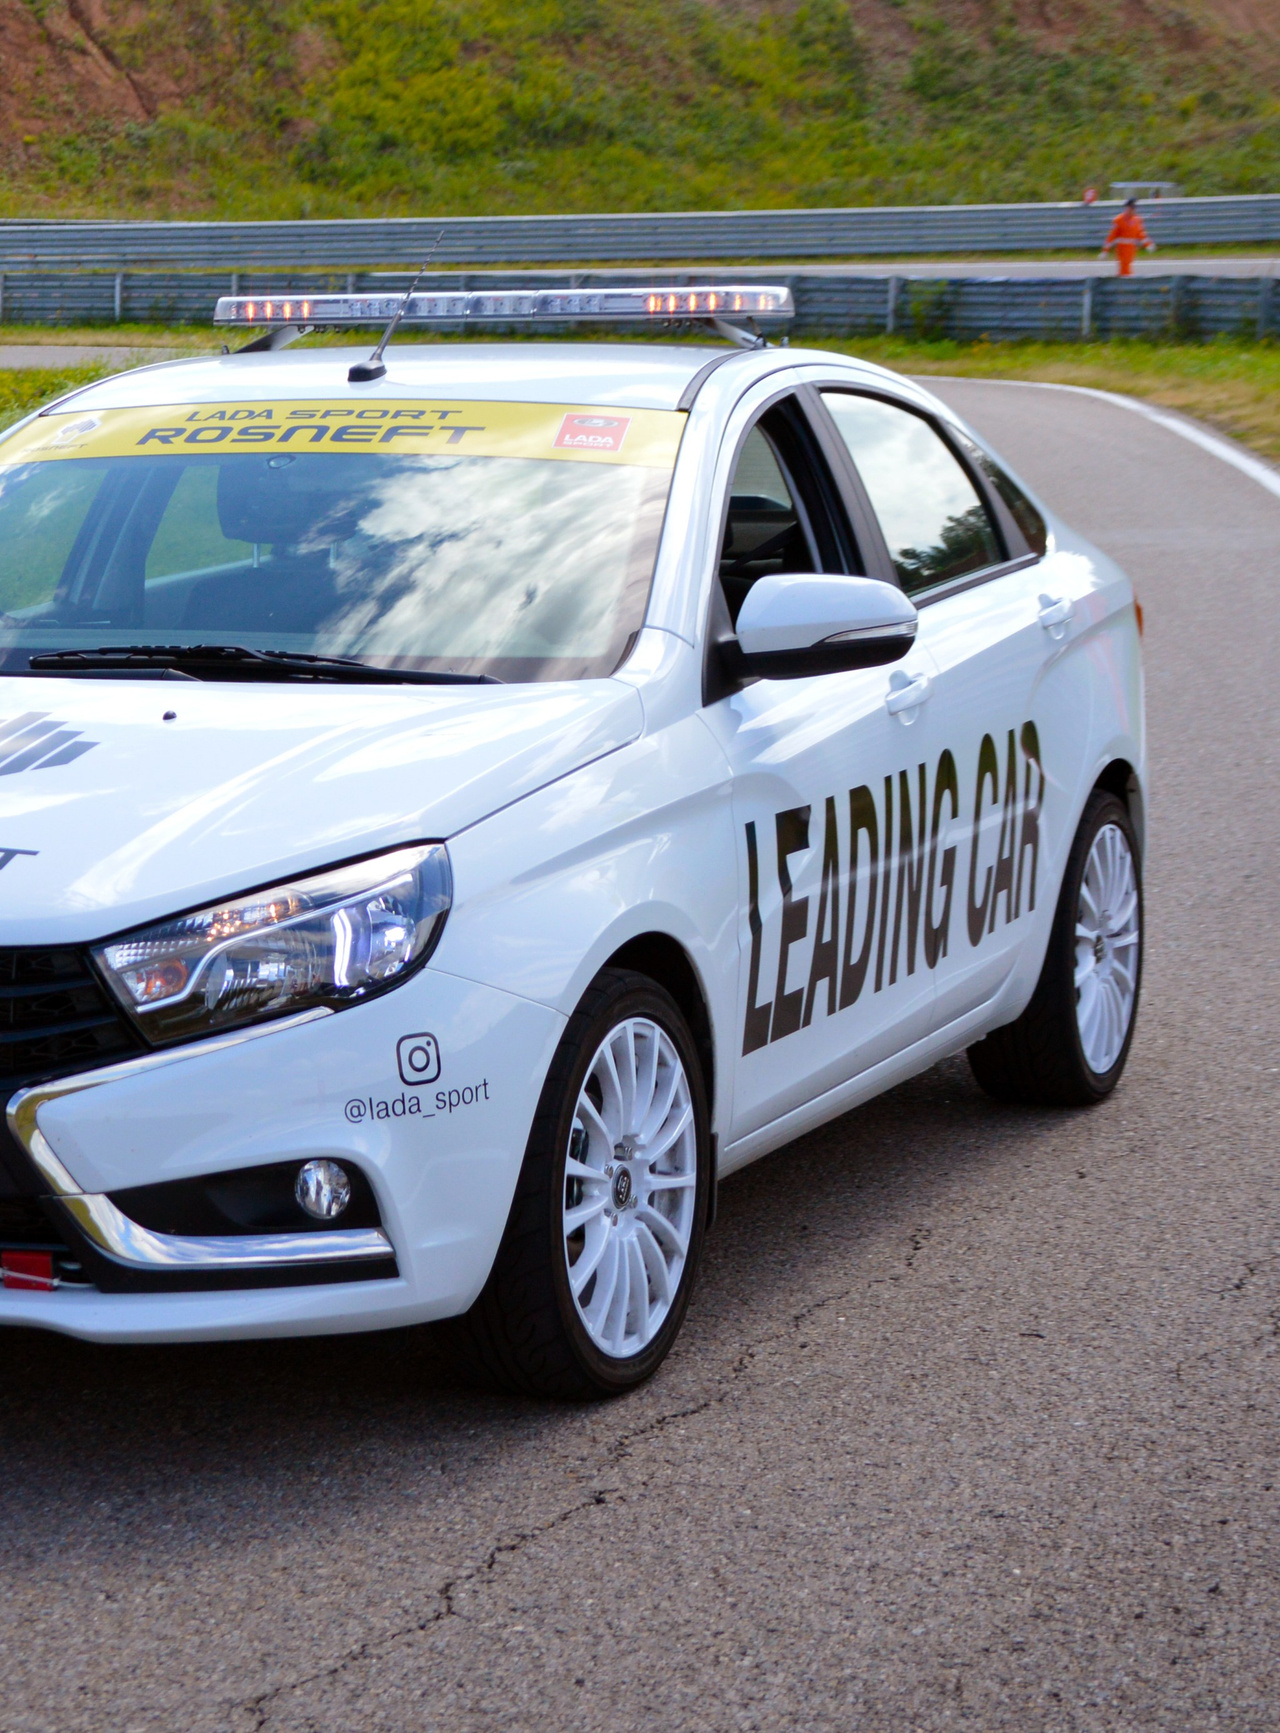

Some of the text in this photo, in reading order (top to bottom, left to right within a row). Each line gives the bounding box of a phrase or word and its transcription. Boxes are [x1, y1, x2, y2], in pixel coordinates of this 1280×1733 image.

[185, 409, 463, 422] LADA SPORT
[135, 425, 486, 446] ROSNEFT
[564, 434, 614, 444] LADA
[741, 719, 1045, 1058] LEADING CAR
[344, 1078, 490, 1124] @lada_sport
